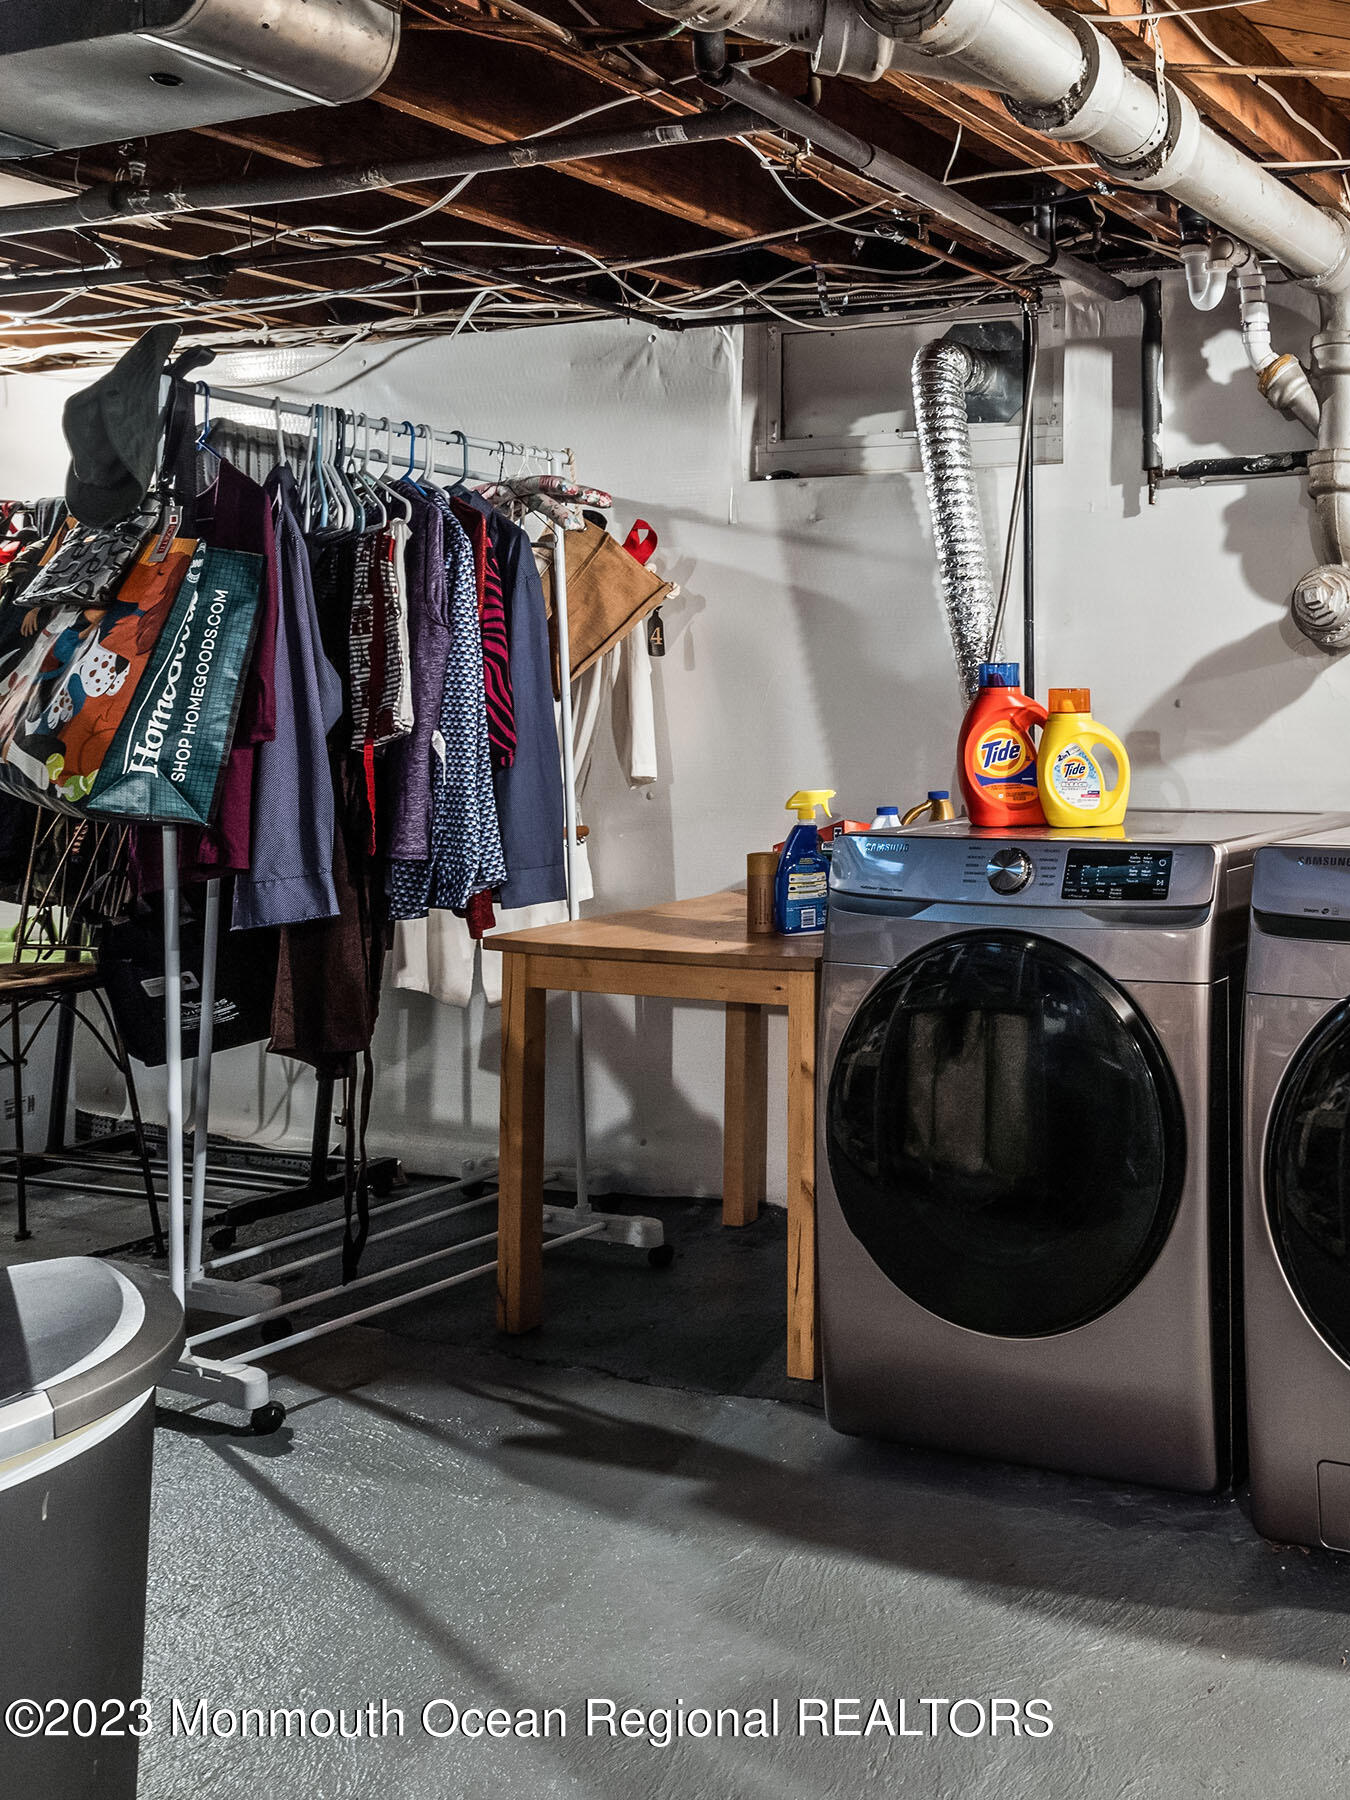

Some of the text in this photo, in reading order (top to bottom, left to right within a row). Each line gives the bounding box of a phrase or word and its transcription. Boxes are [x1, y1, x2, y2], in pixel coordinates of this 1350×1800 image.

[650, 627, 663, 645] 4
[171, 589, 229, 783] SHOP HOMEGOODS.COM
[981, 738, 1021, 769] Tide
[1064, 763, 1085, 778] Tide
[864, 842, 910, 853] SAMSUNG
